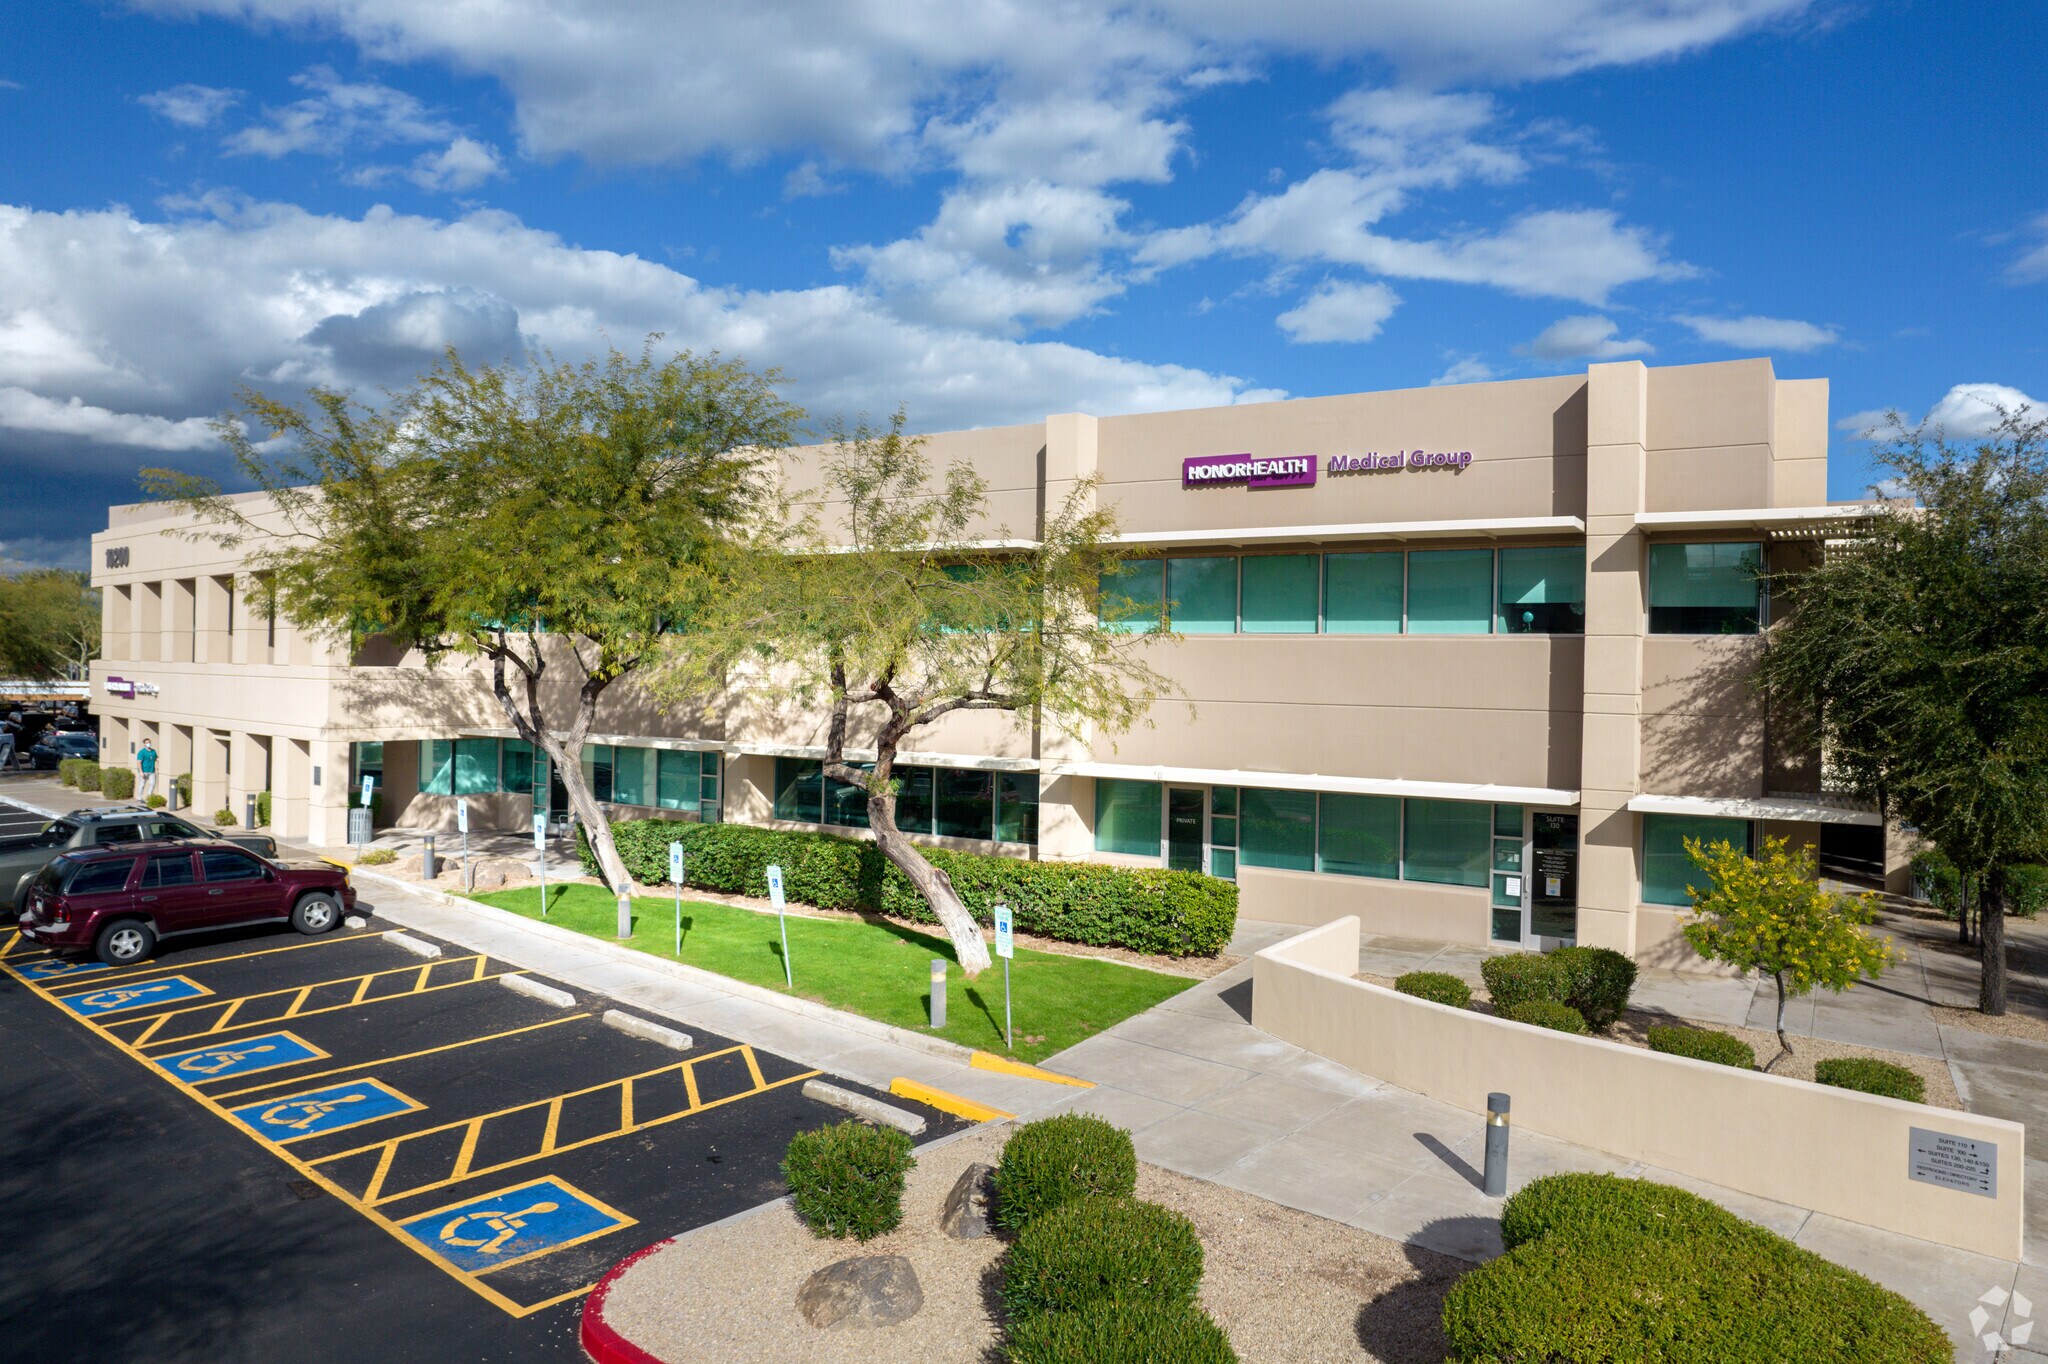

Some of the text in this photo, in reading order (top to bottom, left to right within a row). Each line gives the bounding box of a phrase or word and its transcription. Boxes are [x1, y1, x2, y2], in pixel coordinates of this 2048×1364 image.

[1188, 449, 1473, 480] HONORHEALTH Medical Group
[1938, 1138, 1956, 1146] SUITE
[1936, 1145, 1954, 1153] SUITE
[1927, 1150, 1950, 1159] SUITES
[1931, 1158, 1952, 1167] SUITES
[1935, 1175, 1970, 1187] ELEVATORS
